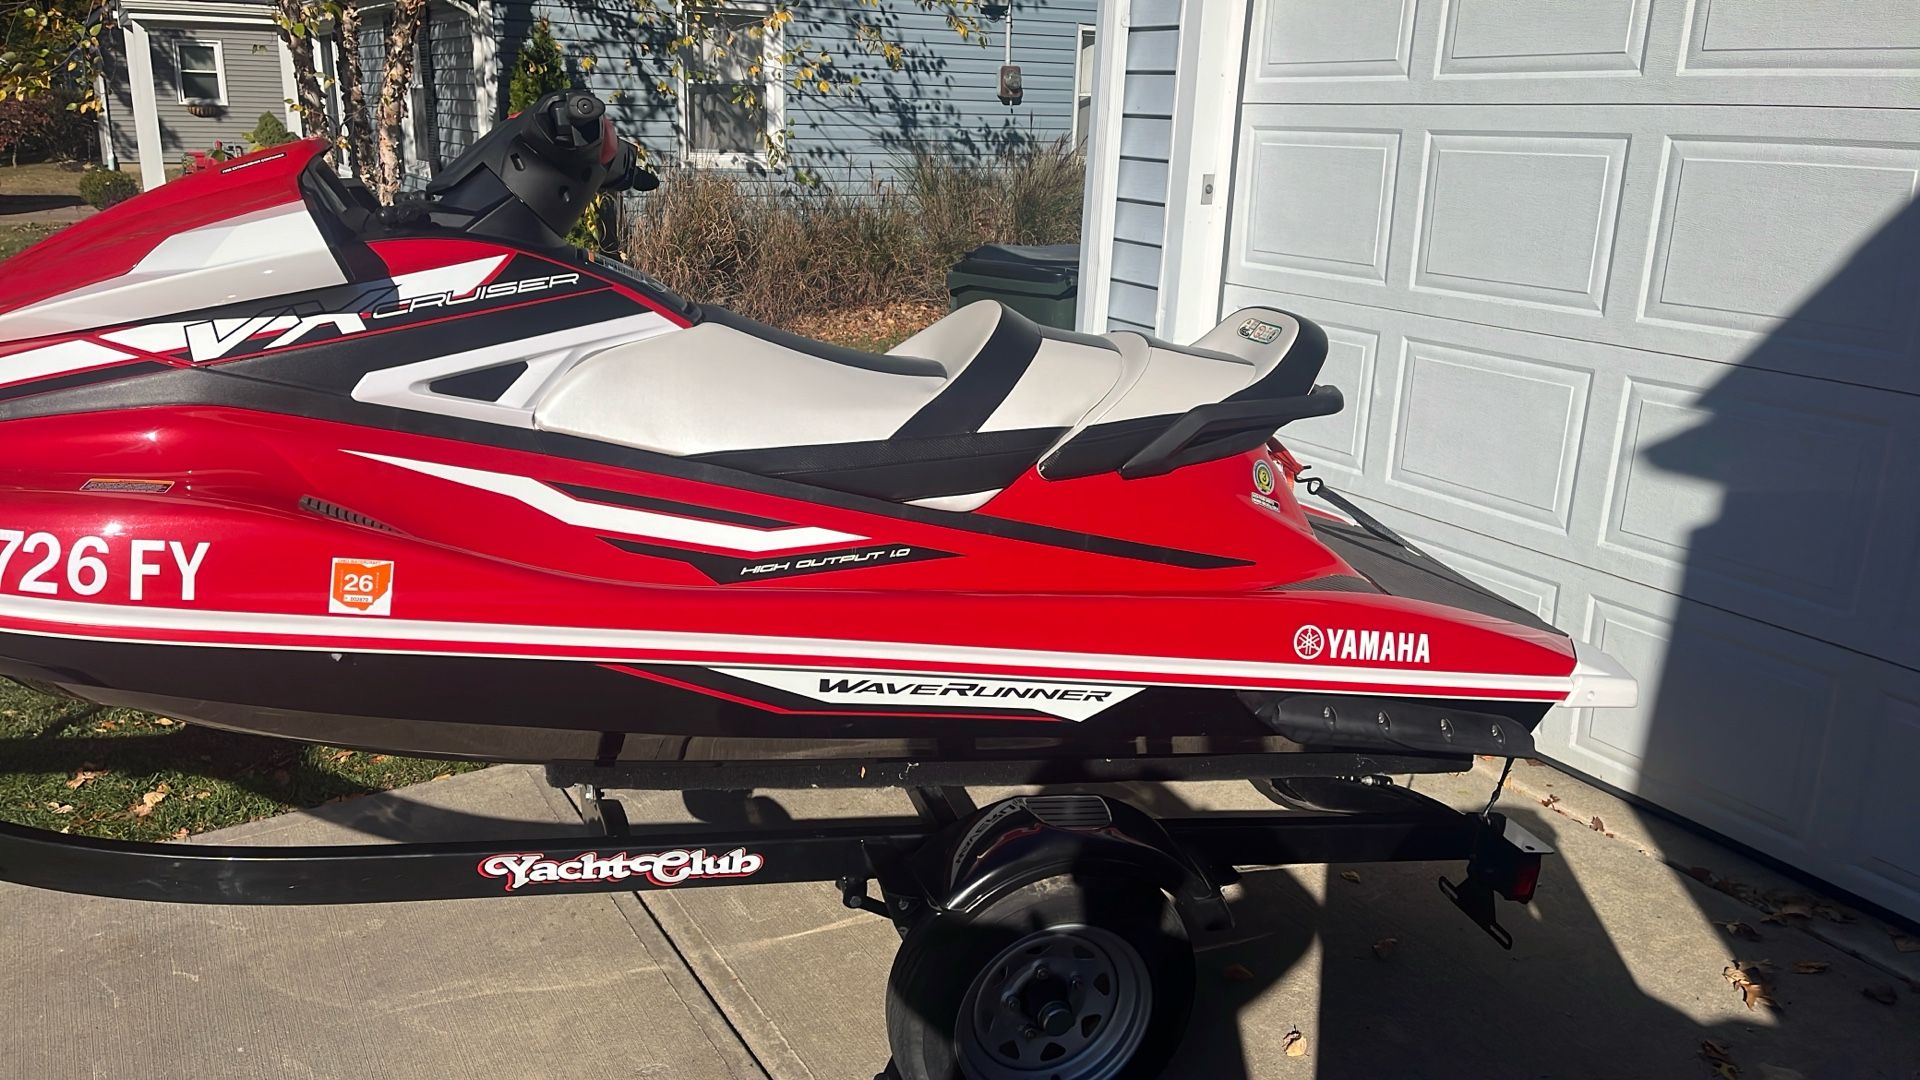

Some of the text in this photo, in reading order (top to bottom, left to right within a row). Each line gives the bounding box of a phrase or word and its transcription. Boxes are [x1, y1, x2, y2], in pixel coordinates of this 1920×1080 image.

[183, 272, 580, 364] VX CRUISER
[129, 539, 211, 601] FY
[740, 547, 911, 576] HIGH OUTPUT 1.0
[343, 573, 374, 592] 26
[1326, 628, 1431, 664] YAMAHA
